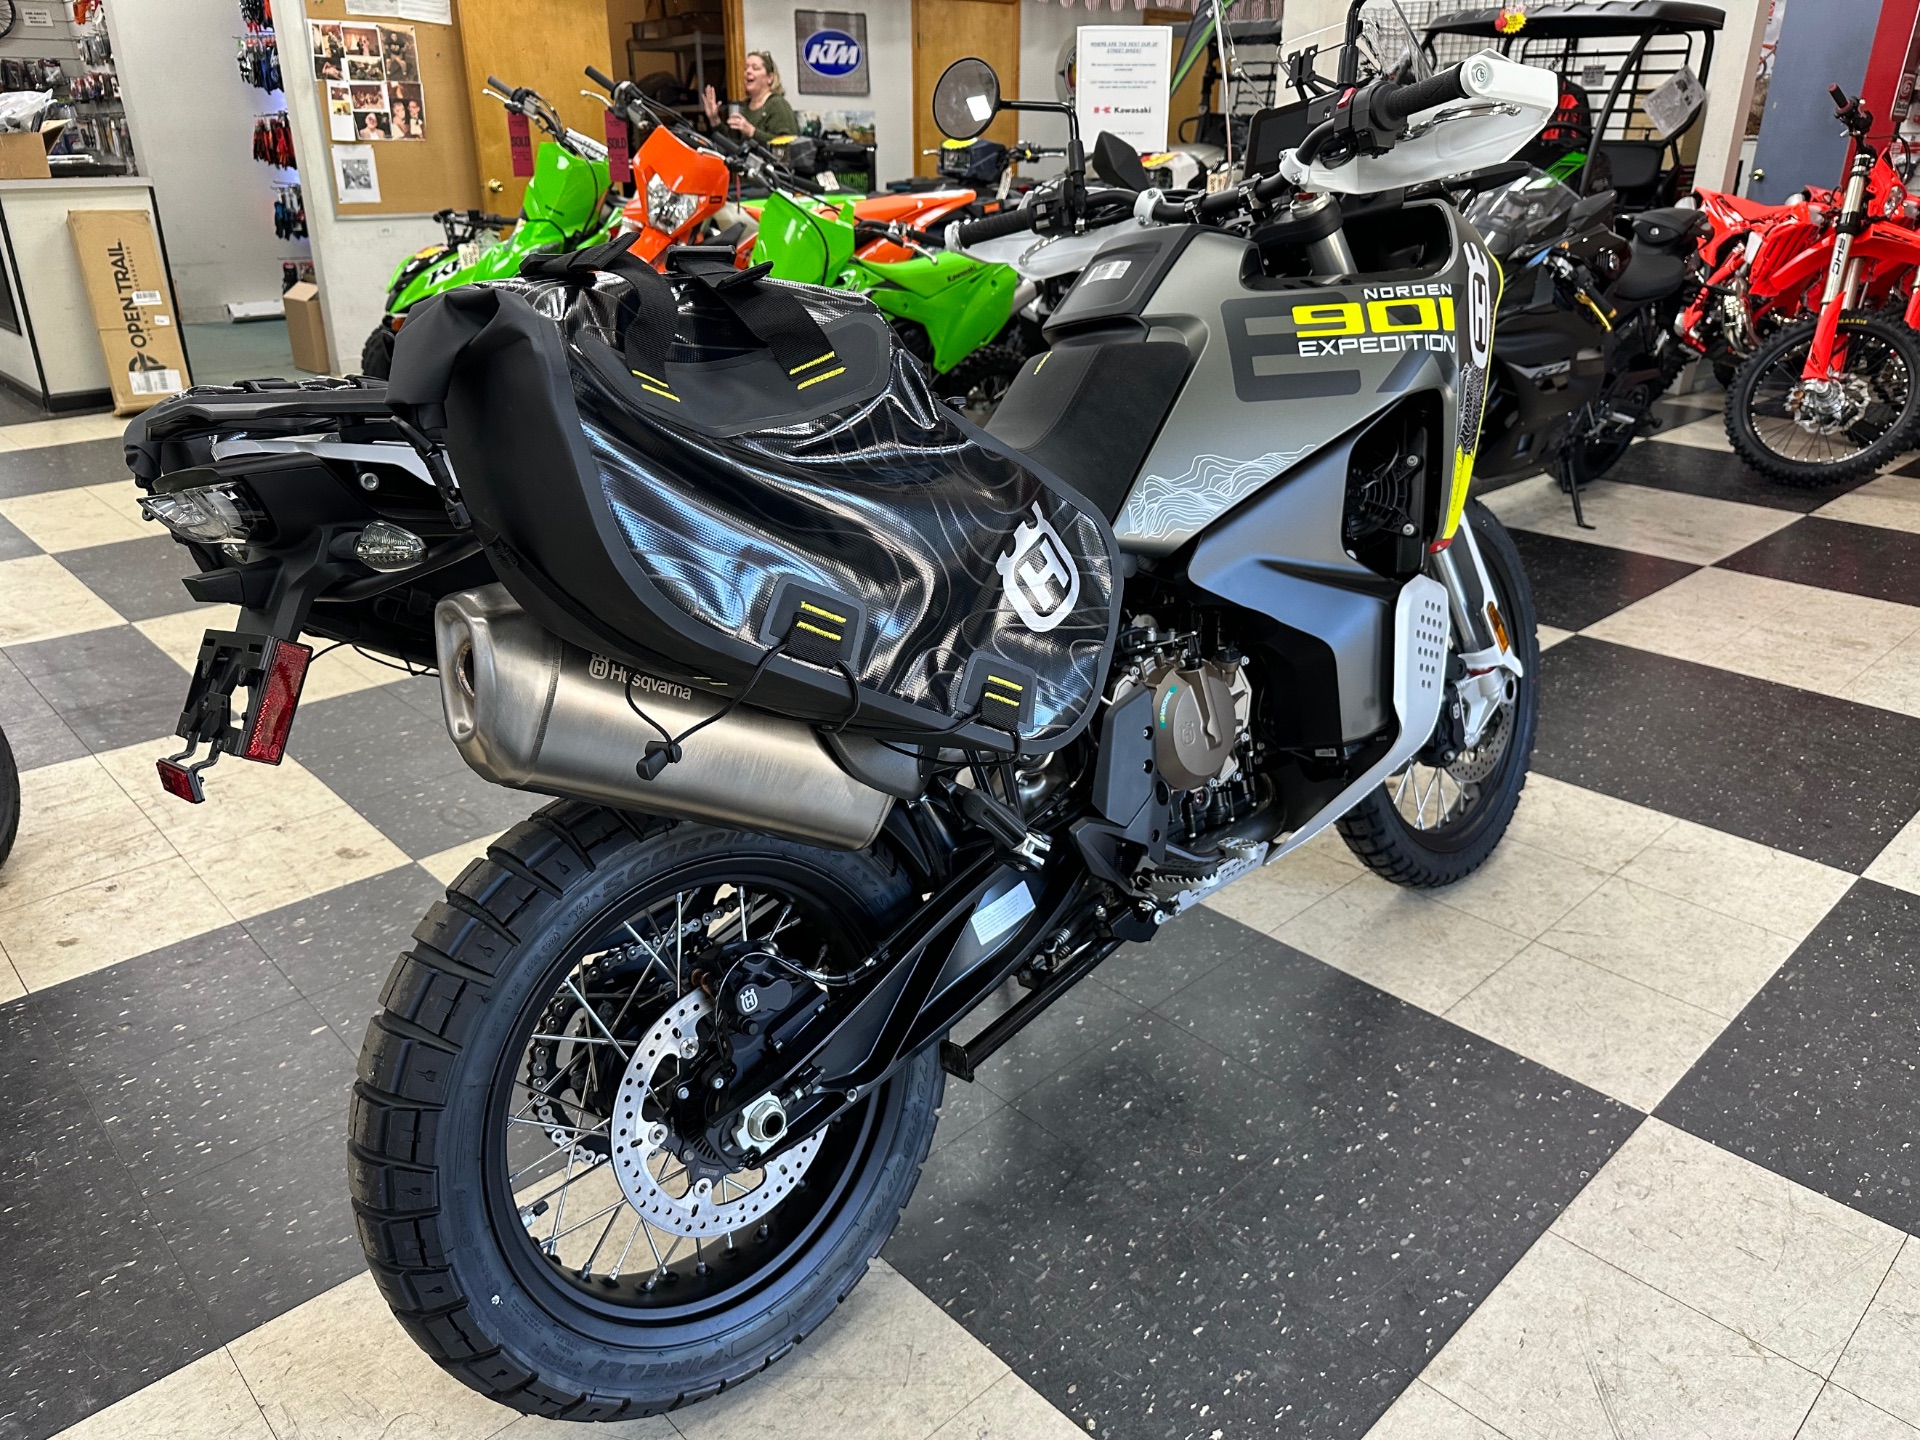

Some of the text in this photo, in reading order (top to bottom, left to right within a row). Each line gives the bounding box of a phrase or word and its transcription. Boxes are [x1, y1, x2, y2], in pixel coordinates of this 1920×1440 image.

[808, 39, 858, 65] KTM
[1114, 106, 1151, 114] Kawasaki
[511, 136, 530, 147] SOLD
[608, 137, 626, 149] SOLD
[107, 241, 147, 349] OPEN TRAIL
[1363, 283, 1453, 300] NORDEN
[1291, 297, 1456, 338] 901
[1298, 334, 1456, 358] EXPEDITION
[589, 1347, 725, 1380] PIRELLI
